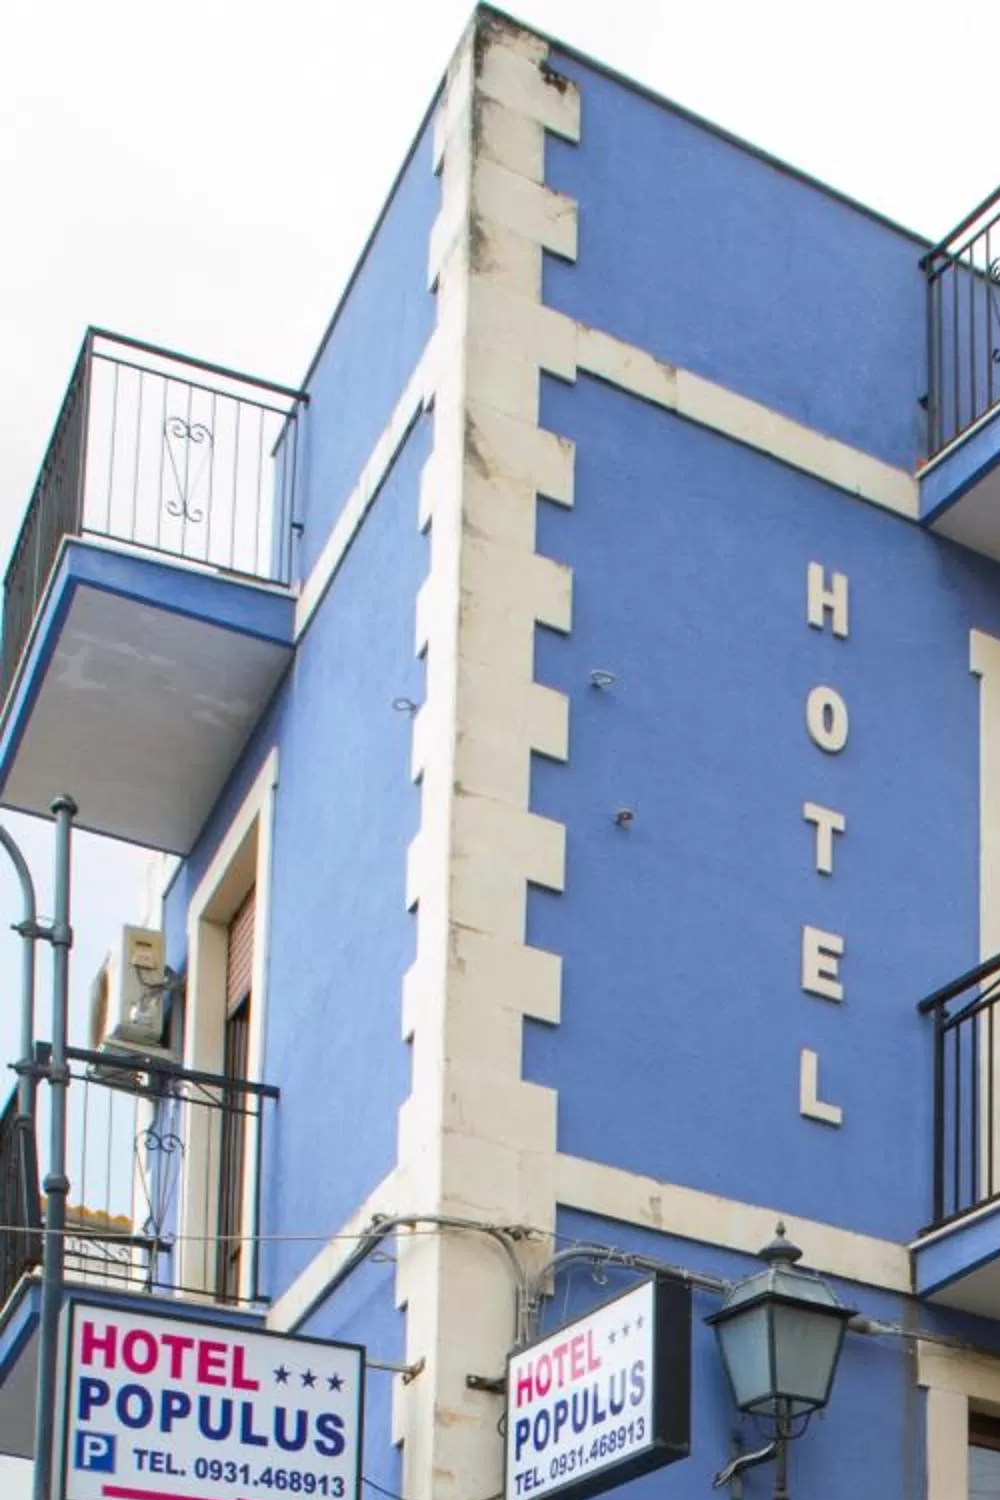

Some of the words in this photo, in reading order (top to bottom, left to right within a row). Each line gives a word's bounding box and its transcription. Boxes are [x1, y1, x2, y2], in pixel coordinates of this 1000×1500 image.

[800, 561, 850, 1128] HOTEL
[81, 1321, 260, 1391] HOTEL
[515, 1329, 601, 1408] HOTEL
[77, 1376, 346, 1456] POPULUS
[515, 1360, 645, 1461] POPULUS
[82, 1437, 109, 1467] P
[133, 1448, 186, 1476] TEL.
[194, 1457, 345, 1498] 0931.468913
[515, 1466, 546, 1495] TEL.
[550, 1417, 645, 1479] 0931.468913
